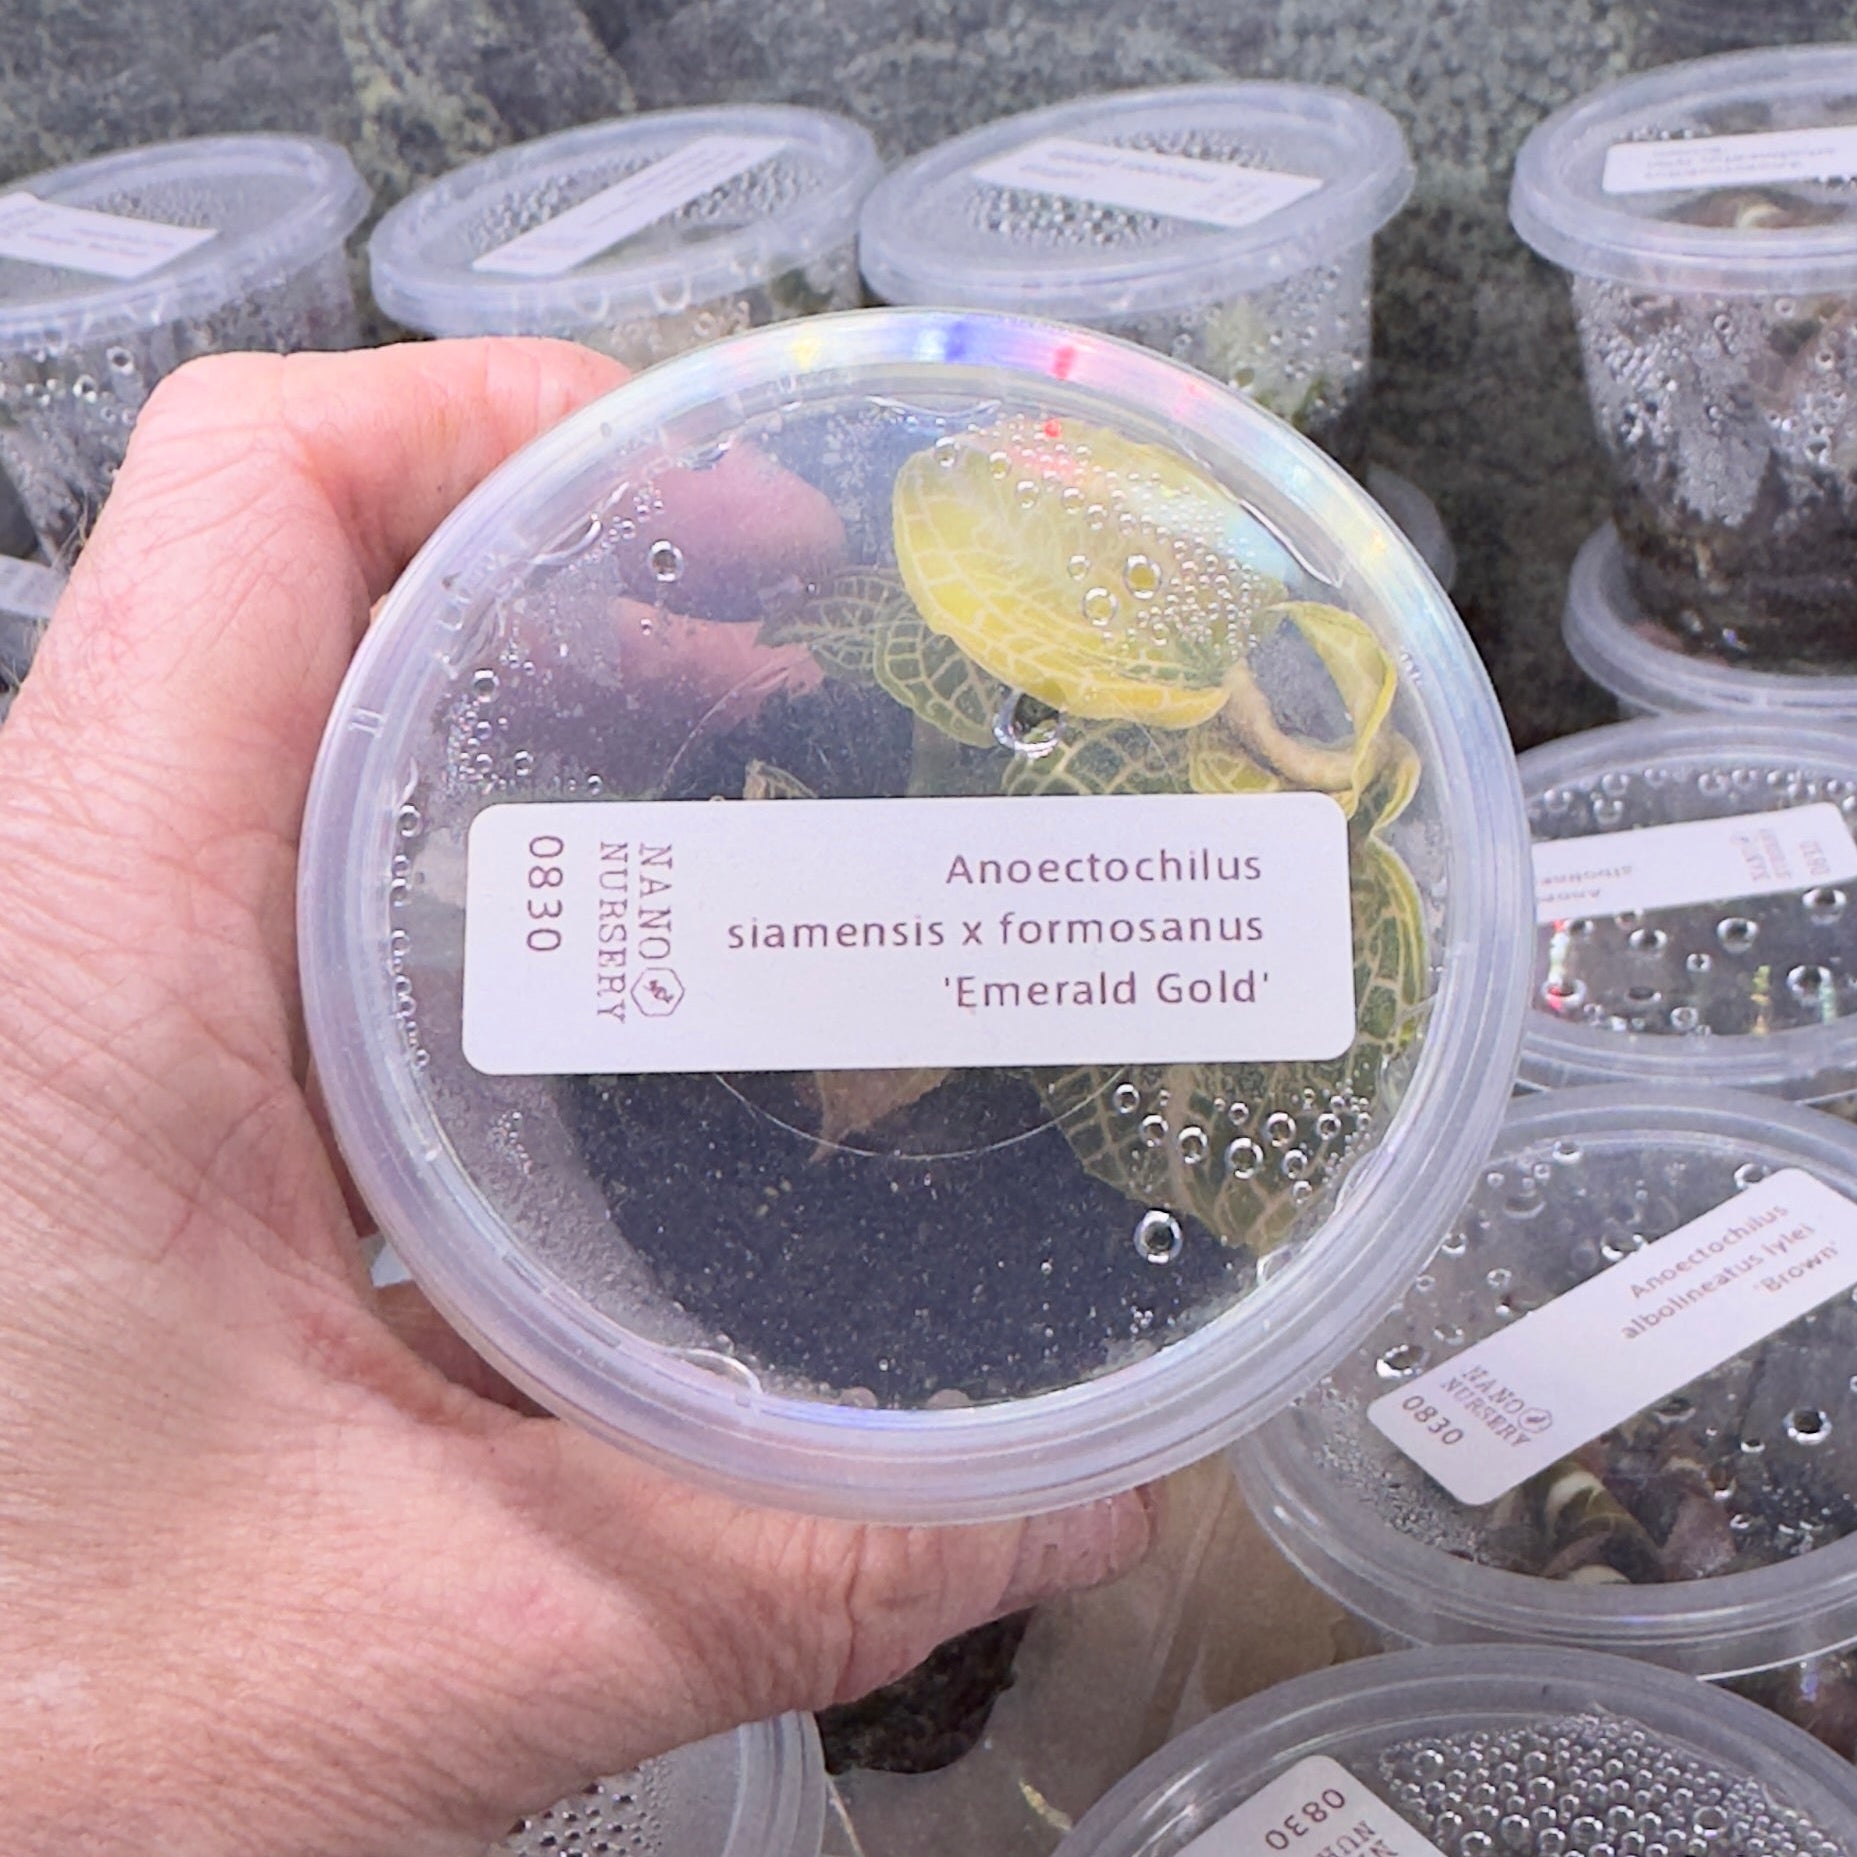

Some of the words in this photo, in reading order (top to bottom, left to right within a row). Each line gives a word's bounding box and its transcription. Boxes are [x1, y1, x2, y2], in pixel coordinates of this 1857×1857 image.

[526, 835, 564, 952] 0830
[945, 848, 1262, 884] Anoectochilus
[596, 841, 629, 1024] NURSERY
[638, 842, 673, 960] NANO
[727, 914, 945, 949] siamensis
[961, 920, 983, 946] x
[999, 911, 1264, 945] formosanus
[944, 971, 1136, 1008] 'Emerald
[1156, 969, 1269, 1004] Gold'
[1620, 1254, 1764, 1340] albolineatus
[1761, 1223, 1816, 1256] lylei
[1629, 1205, 1789, 1300] Anoectochilus
[1402, 1395, 1465, 1445] 0830
[1440, 1377, 1532, 1448] NURSERY
[1461, 1364, 1526, 1415] NANO
[1264, 1788, 1346, 1851] 0830
